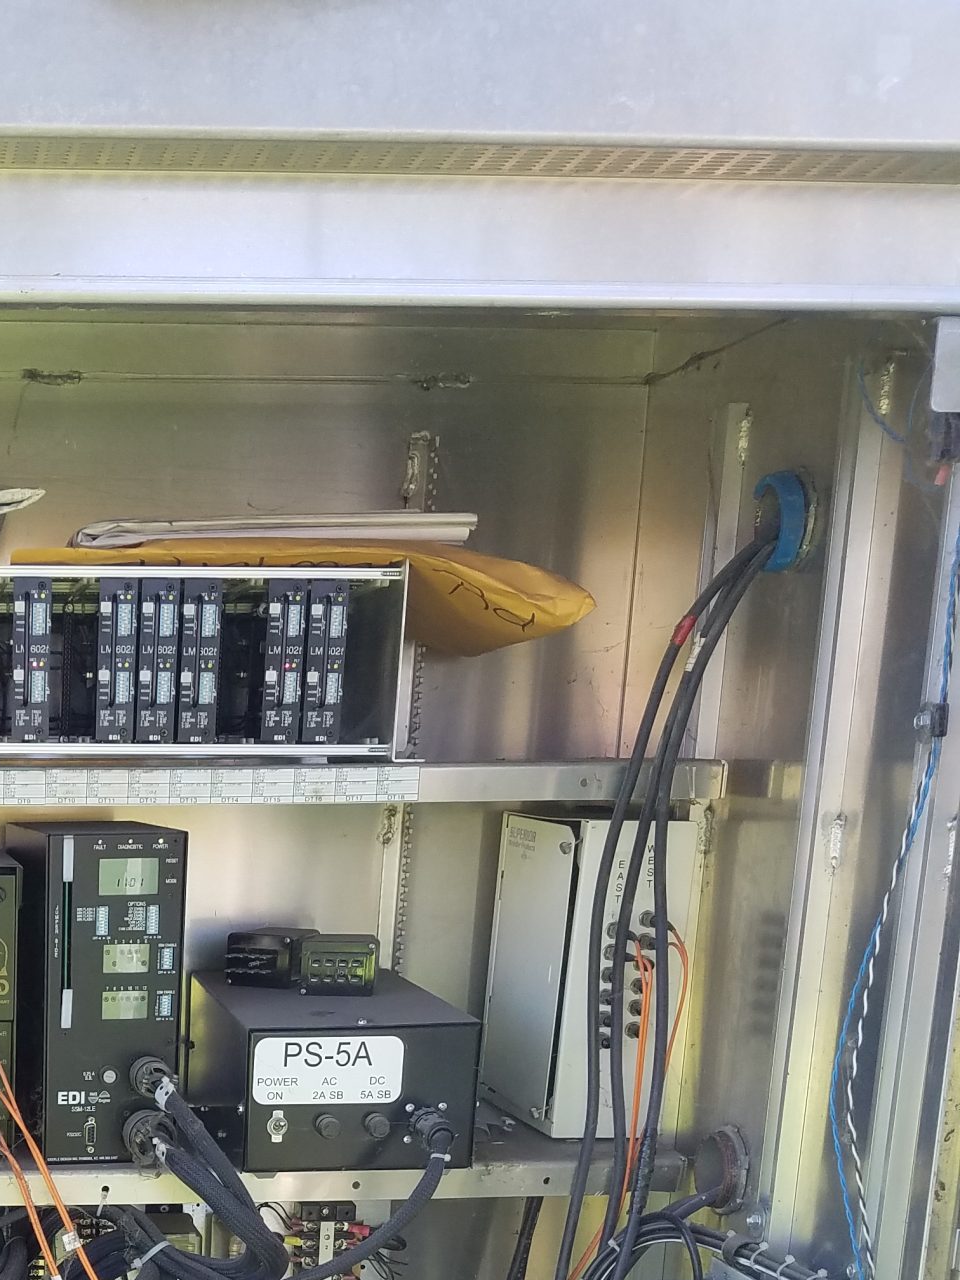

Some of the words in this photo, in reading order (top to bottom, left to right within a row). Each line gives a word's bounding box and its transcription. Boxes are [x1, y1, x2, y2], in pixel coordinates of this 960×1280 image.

[30, 644, 49, 653] 602t
[116, 645, 134, 654] 602t
[158, 646, 176, 654] 602t
[184, 647, 196, 656] LM
[268, 646, 281, 655] LM
[310, 646, 322, 655] LM
[510, 826, 537, 842] SUPERIOR
[615, 860, 626, 903] EAST
[284, 1041, 372, 1067] PS-5A
[257, 1078, 298, 1086] POWER
[322, 1077, 337, 1086] AC
[369, 1076, 386, 1085] DC
[58, 1091, 85, 1105] EDI
[267, 1092, 283, 1100] ON
[312, 1091, 326, 1100] 2A
[329, 1091, 344, 1099] SB
[360, 1090, 373, 1099] 5A
[377, 1090, 392, 1099] SB
